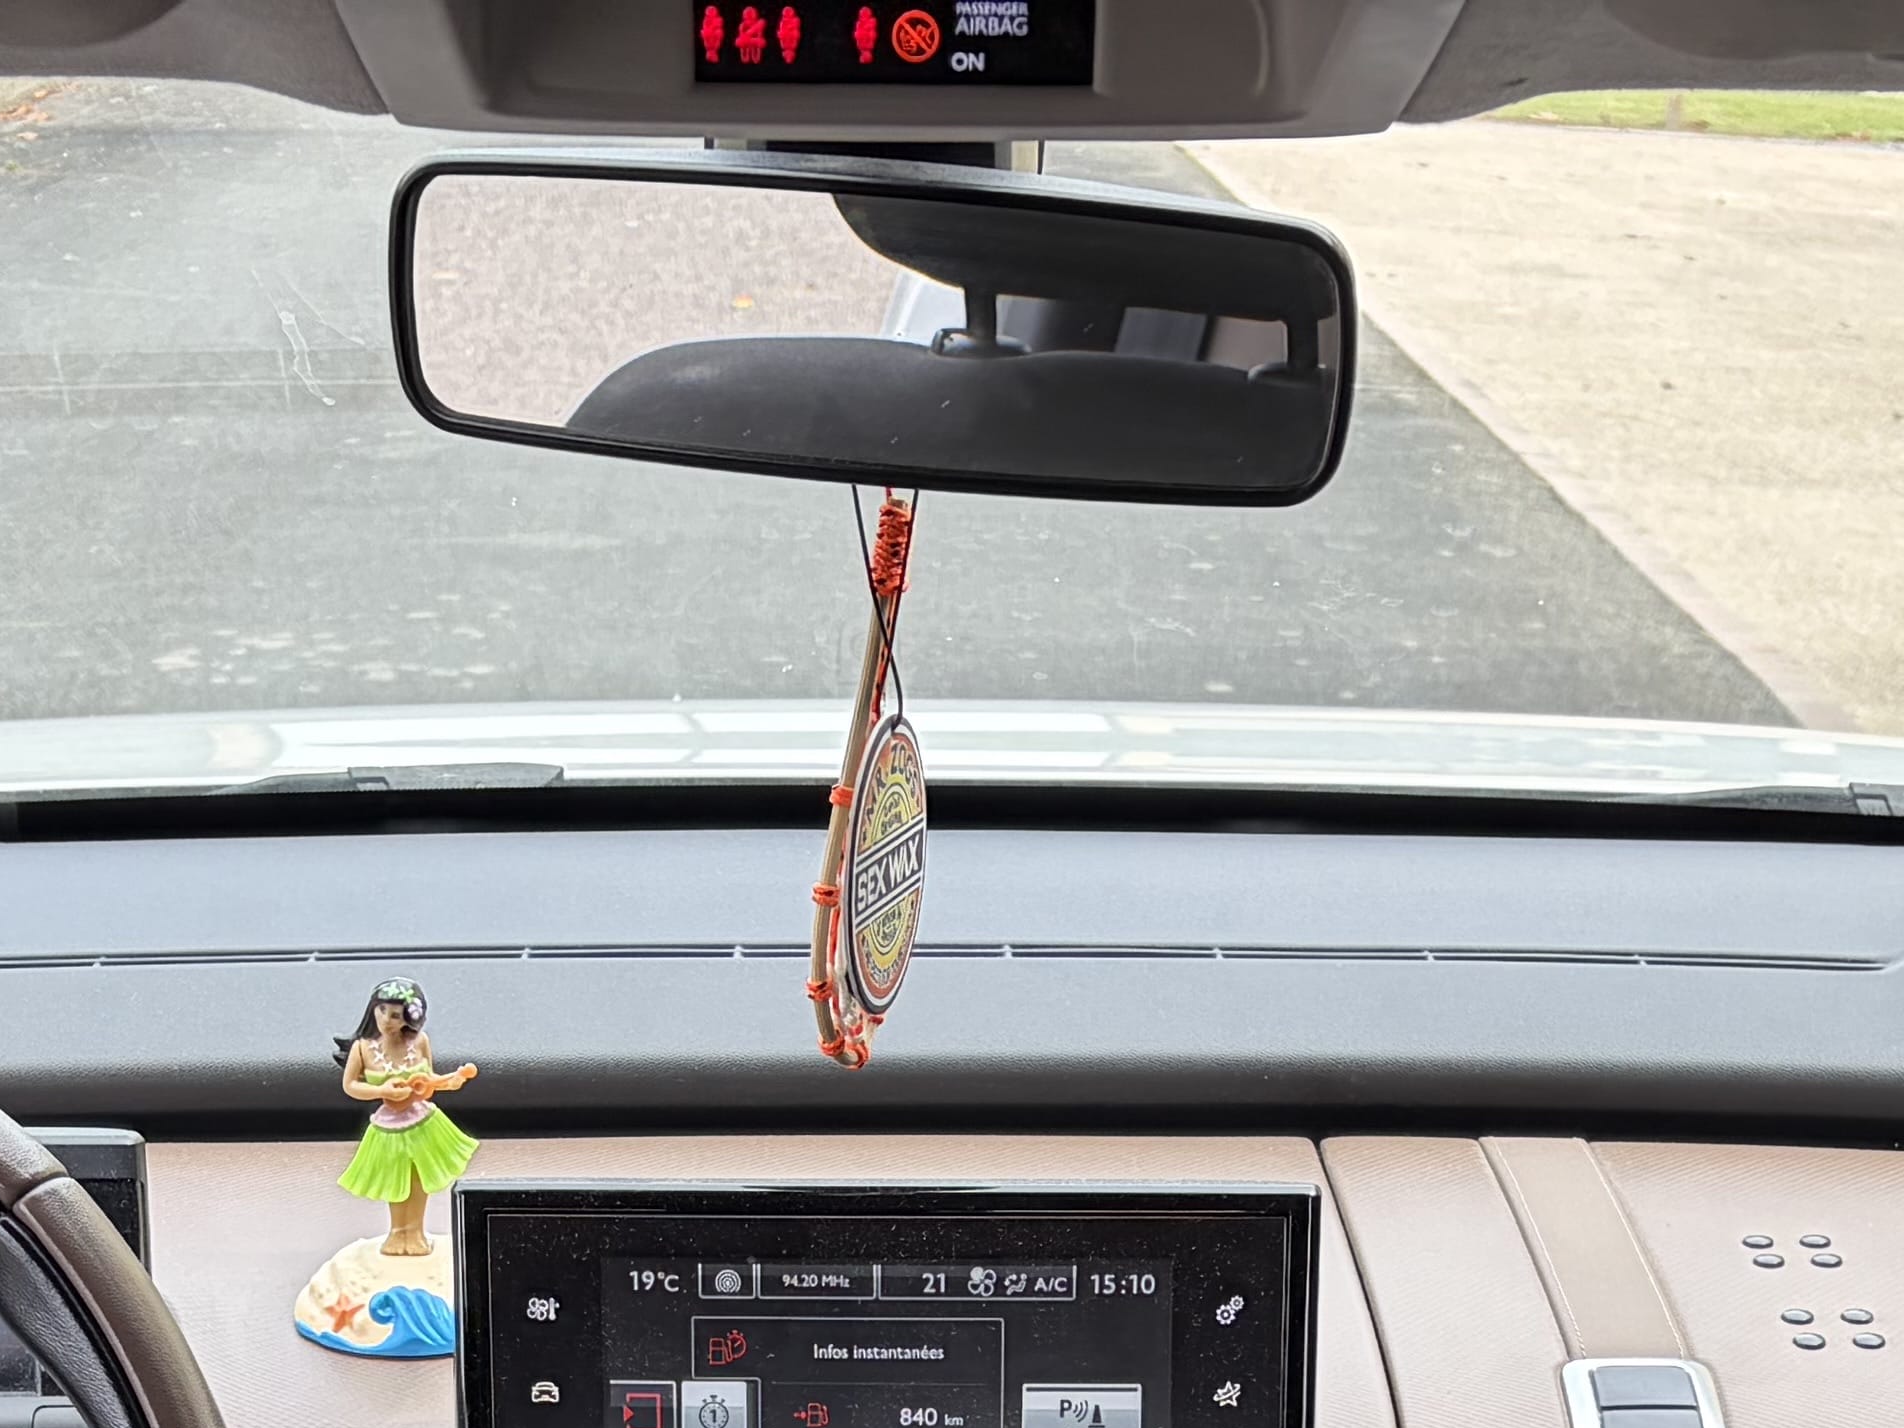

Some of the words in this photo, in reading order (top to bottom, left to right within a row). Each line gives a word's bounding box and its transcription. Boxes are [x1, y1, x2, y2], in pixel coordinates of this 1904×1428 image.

[955, 1, 1029, 16] PASSENGER
[955, 16, 1029, 37] AIRBAG
[951, 51, 986, 72] ON
[856, 855, 888, 913] SEX
[888, 833, 921, 889] WAX
[628, 1269, 681, 1293] 19°C
[781, 1273, 819, 1288] 94.20
[820, 1273, 851, 1289] MHz
[921, 1272, 947, 1294] 21
[1033, 1276, 1069, 1293] A/C
[1089, 1273, 1157, 1296] 15:10
[812, 1343, 849, 1360] Infos
[852, 1343, 946, 1361] instantanées
[899, 1407, 939, 1427] 840
[943, 1413, 965, 1427] km
